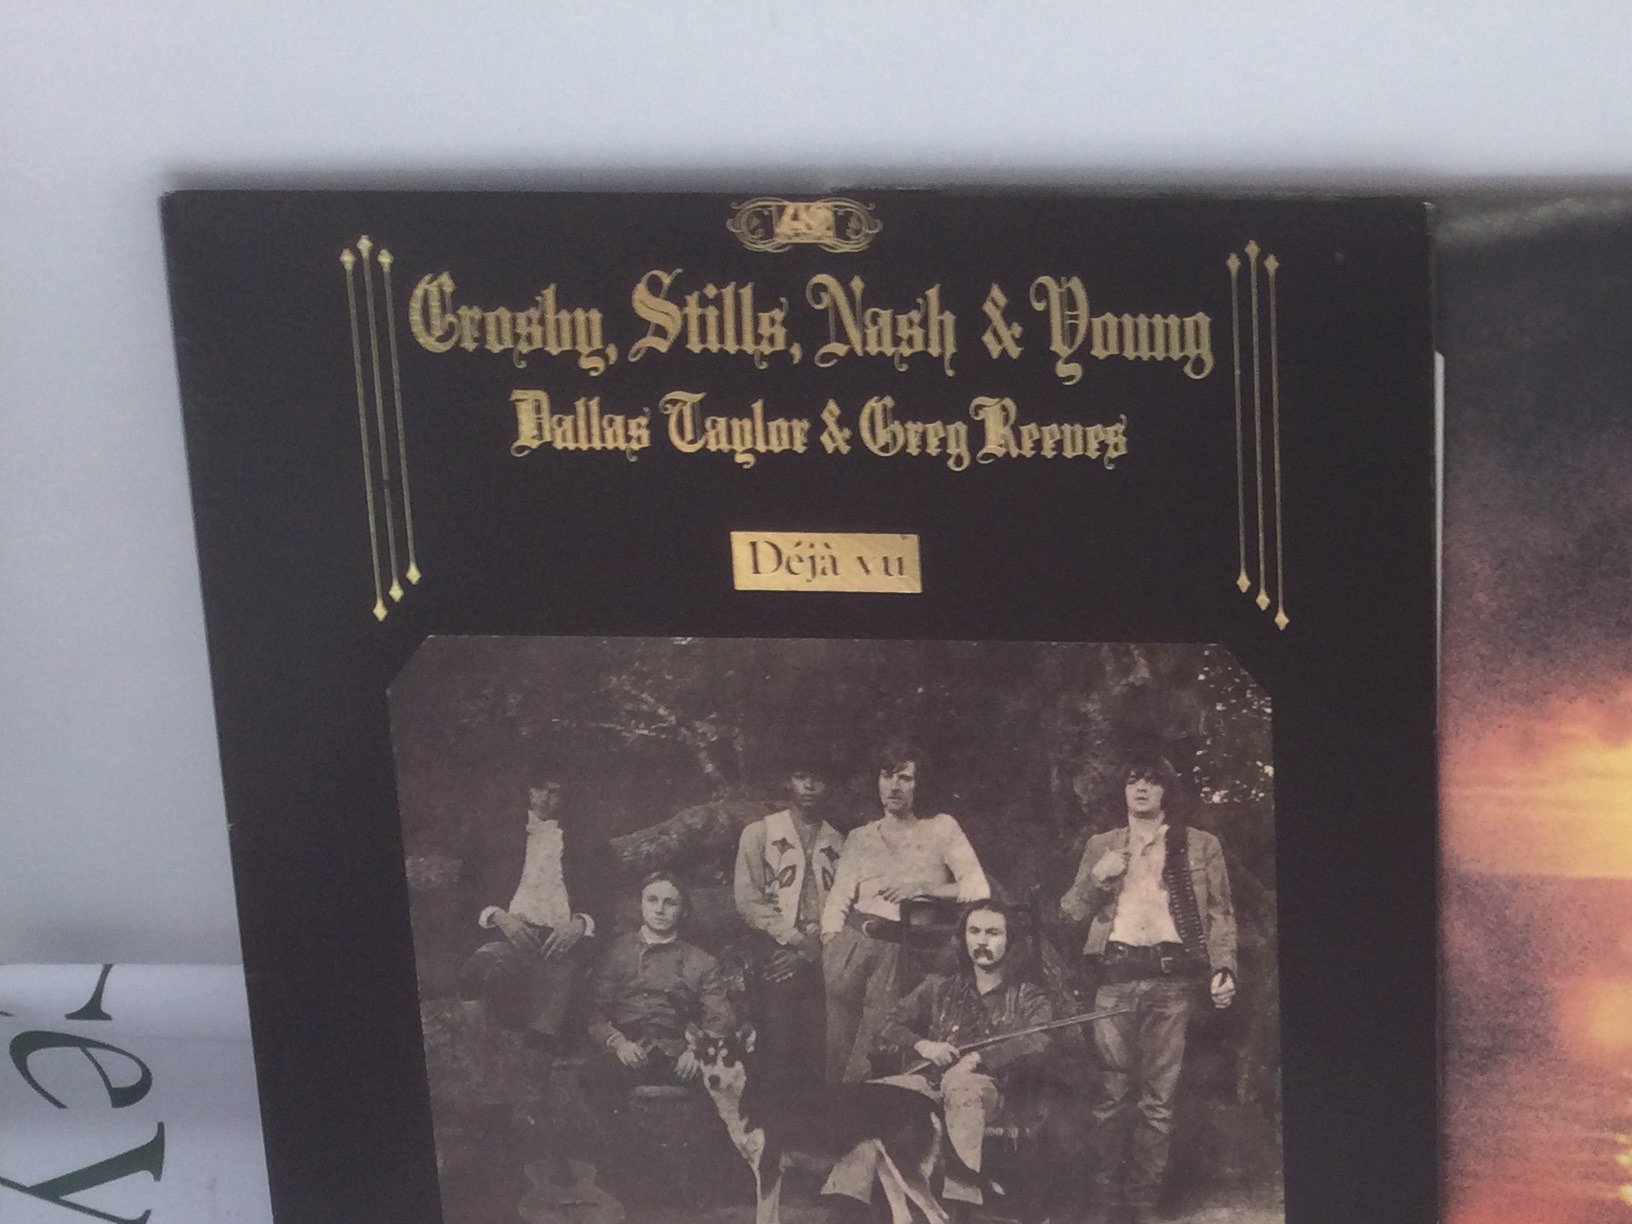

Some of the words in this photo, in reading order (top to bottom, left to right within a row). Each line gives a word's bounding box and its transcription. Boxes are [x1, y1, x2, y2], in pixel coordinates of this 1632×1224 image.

[627, 268, 804, 370] Stills,
[806, 275, 957, 375] Nash
[981, 283, 1024, 360] &
[1029, 275, 1214, 385] Young
[509, 389, 651, 461] Dallas
[659, 391, 810, 467] Taylor
[819, 399, 852, 453] &
[859, 400, 971, 471] Greg
[971, 397, 1129, 469] Reeves
[748, 540, 842, 582] Déjà
[855, 546, 908, 579] vu
